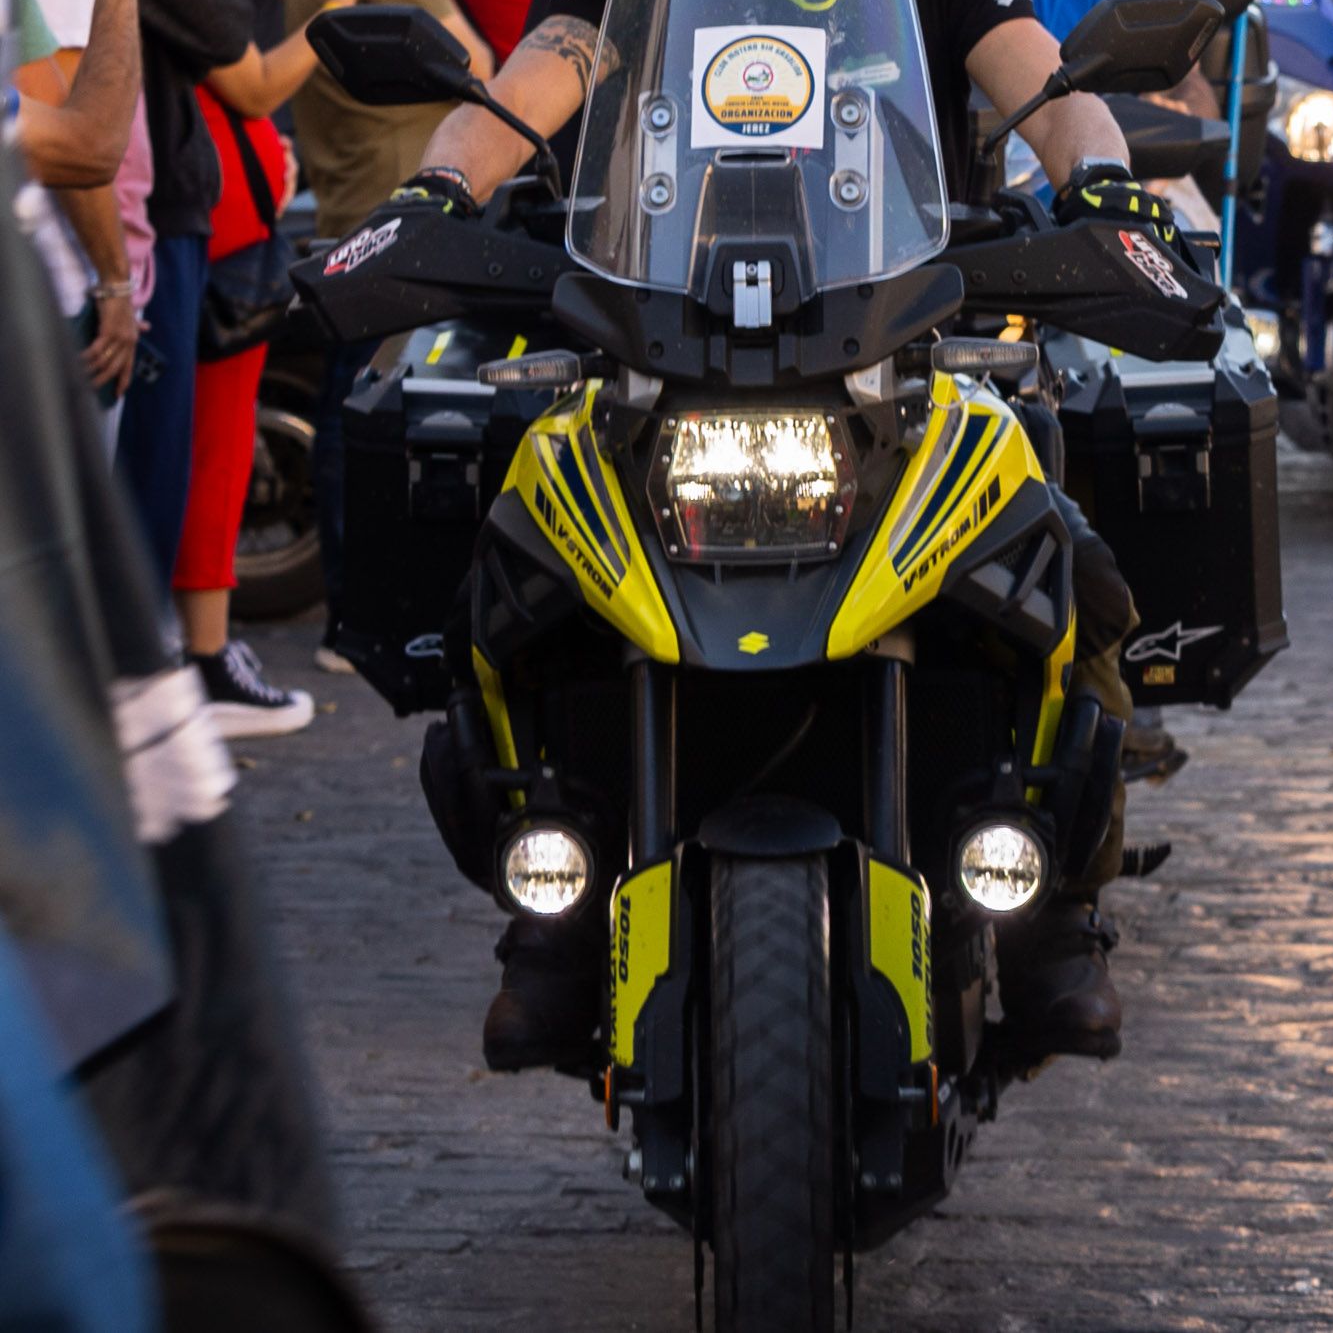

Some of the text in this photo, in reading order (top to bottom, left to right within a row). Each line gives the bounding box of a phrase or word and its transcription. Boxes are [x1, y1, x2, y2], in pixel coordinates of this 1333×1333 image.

[742, 122, 770, 135] JEREZ
[618, 895, 631, 985] 1050
[911, 890, 923, 981] 1050
